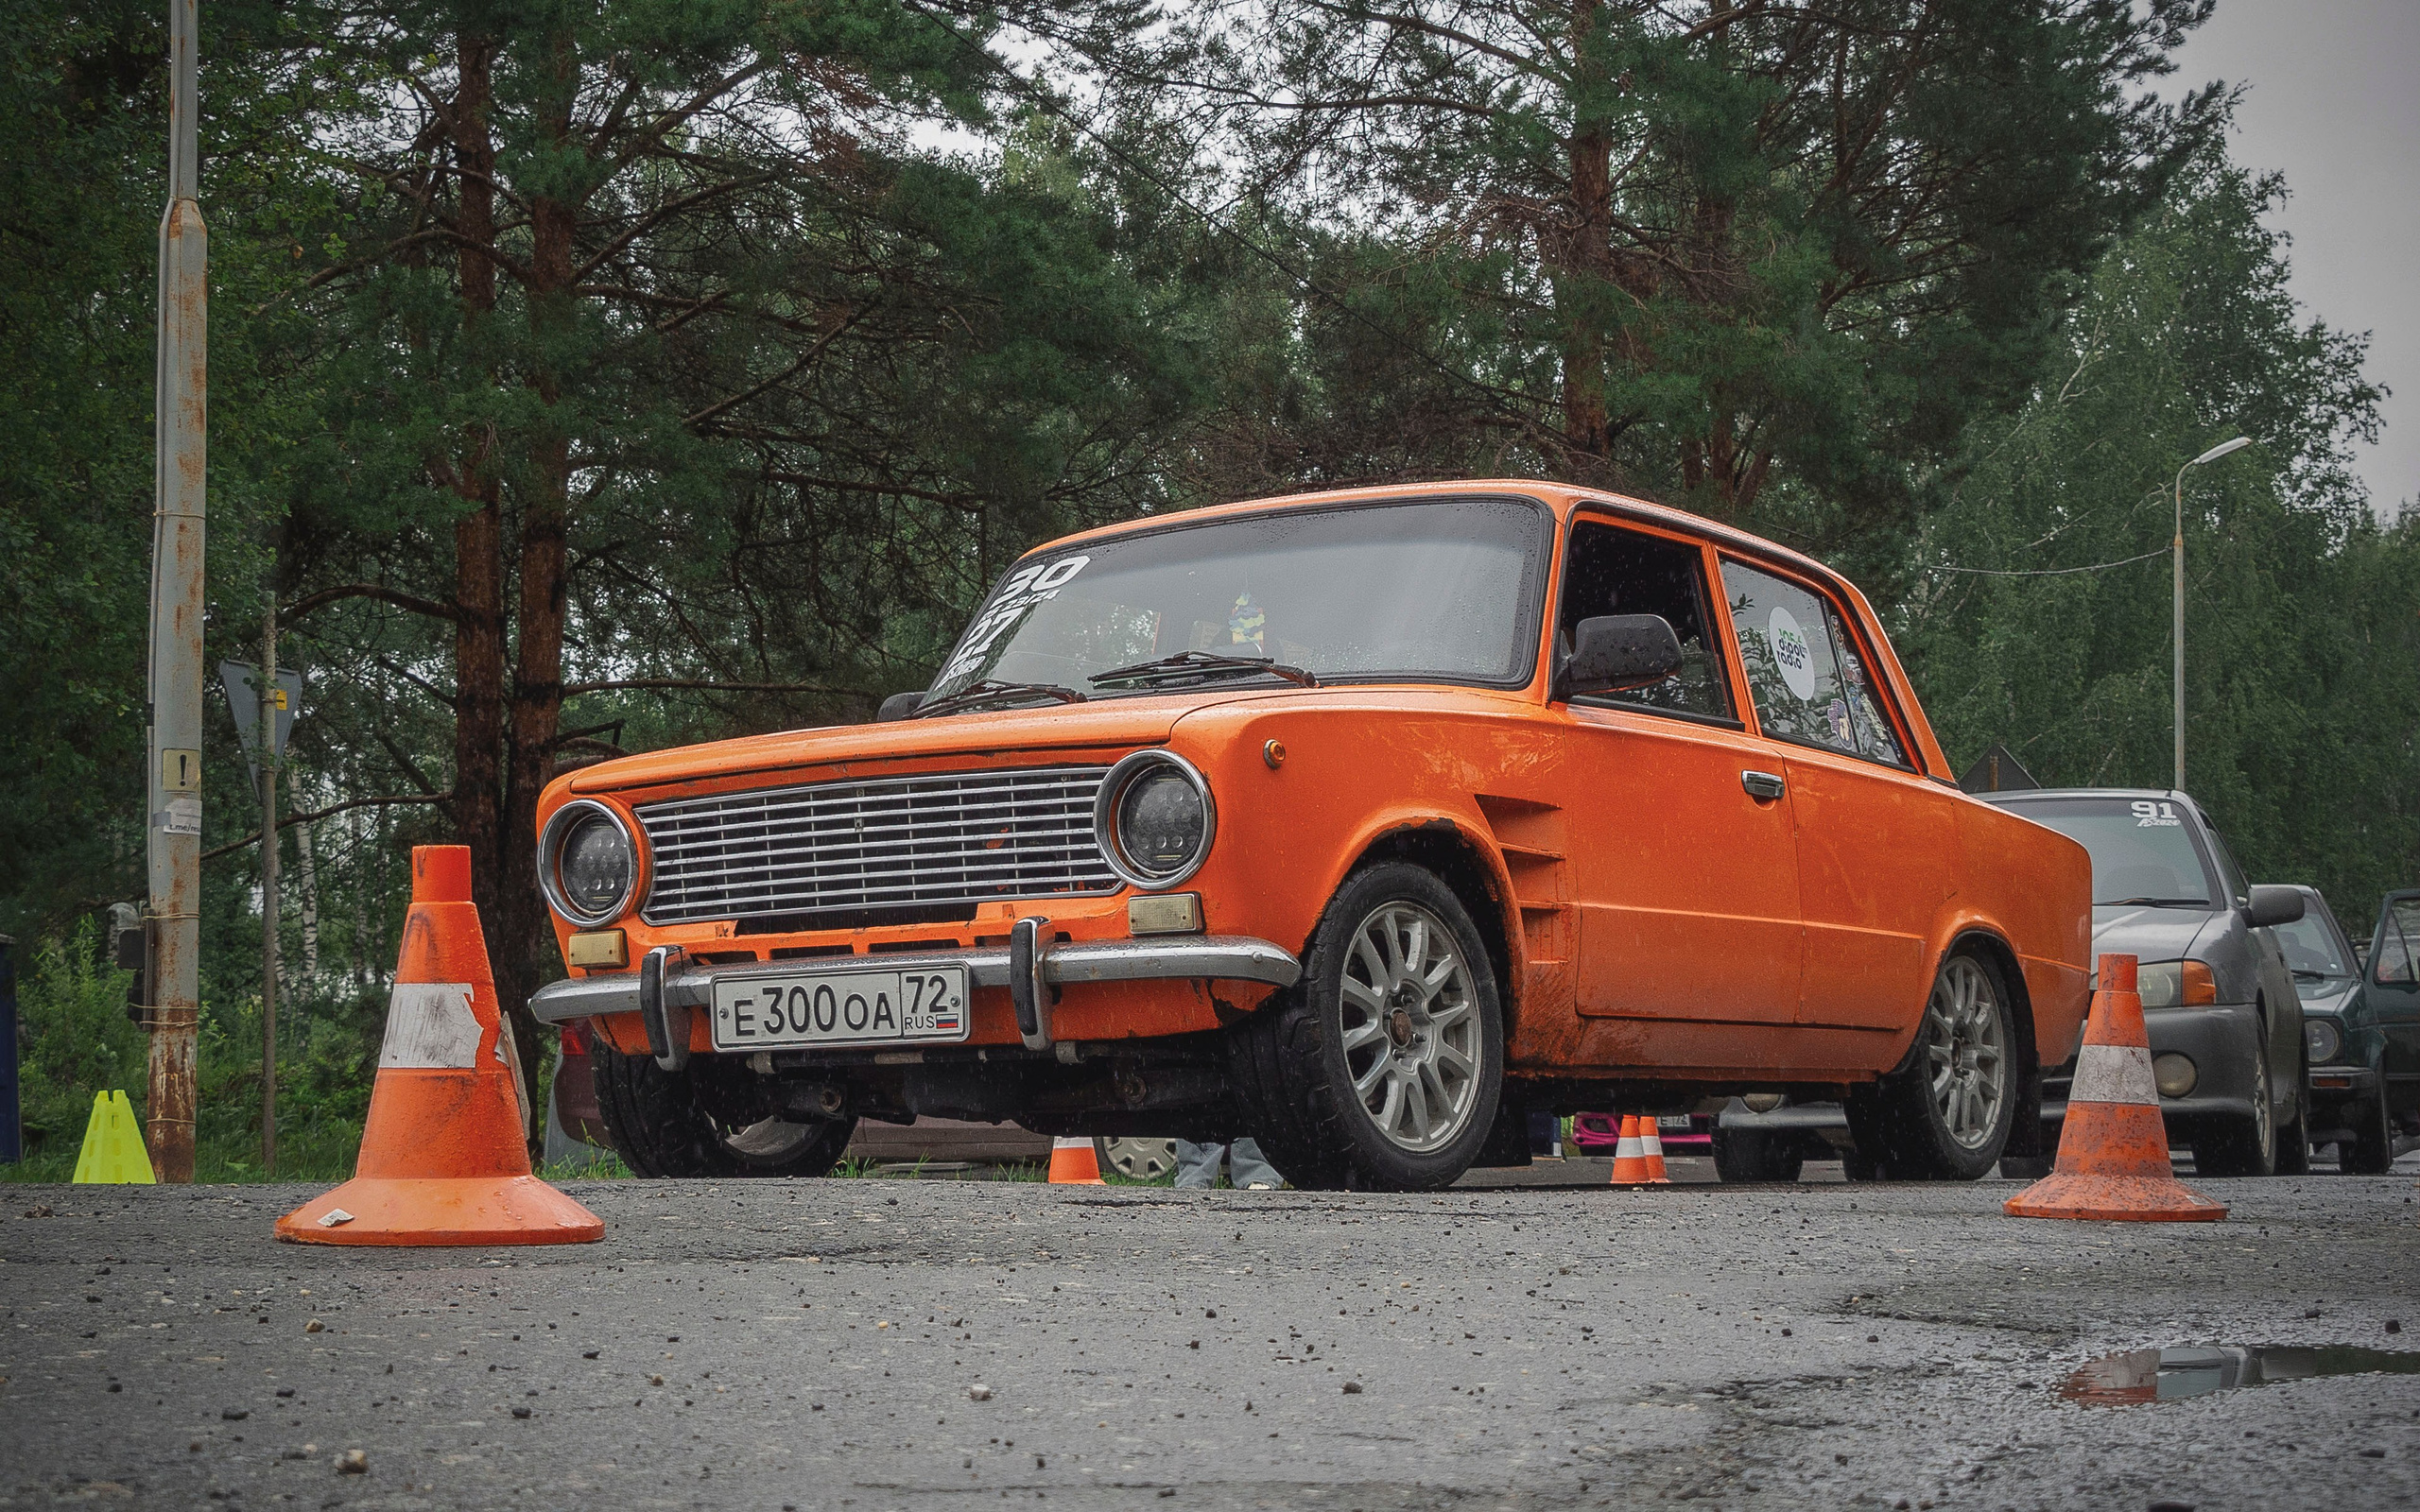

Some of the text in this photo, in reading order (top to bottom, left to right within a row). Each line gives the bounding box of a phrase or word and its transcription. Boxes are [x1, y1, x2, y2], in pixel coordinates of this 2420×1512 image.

[990, 555, 1091, 610] 30
[947, 607, 1026, 669] 27
[1776, 649, 1803, 670] radio
[2131, 800, 2177, 819] 91
[734, 974, 948, 1037] E300OA 72
[904, 1015, 936, 1030] RUS
